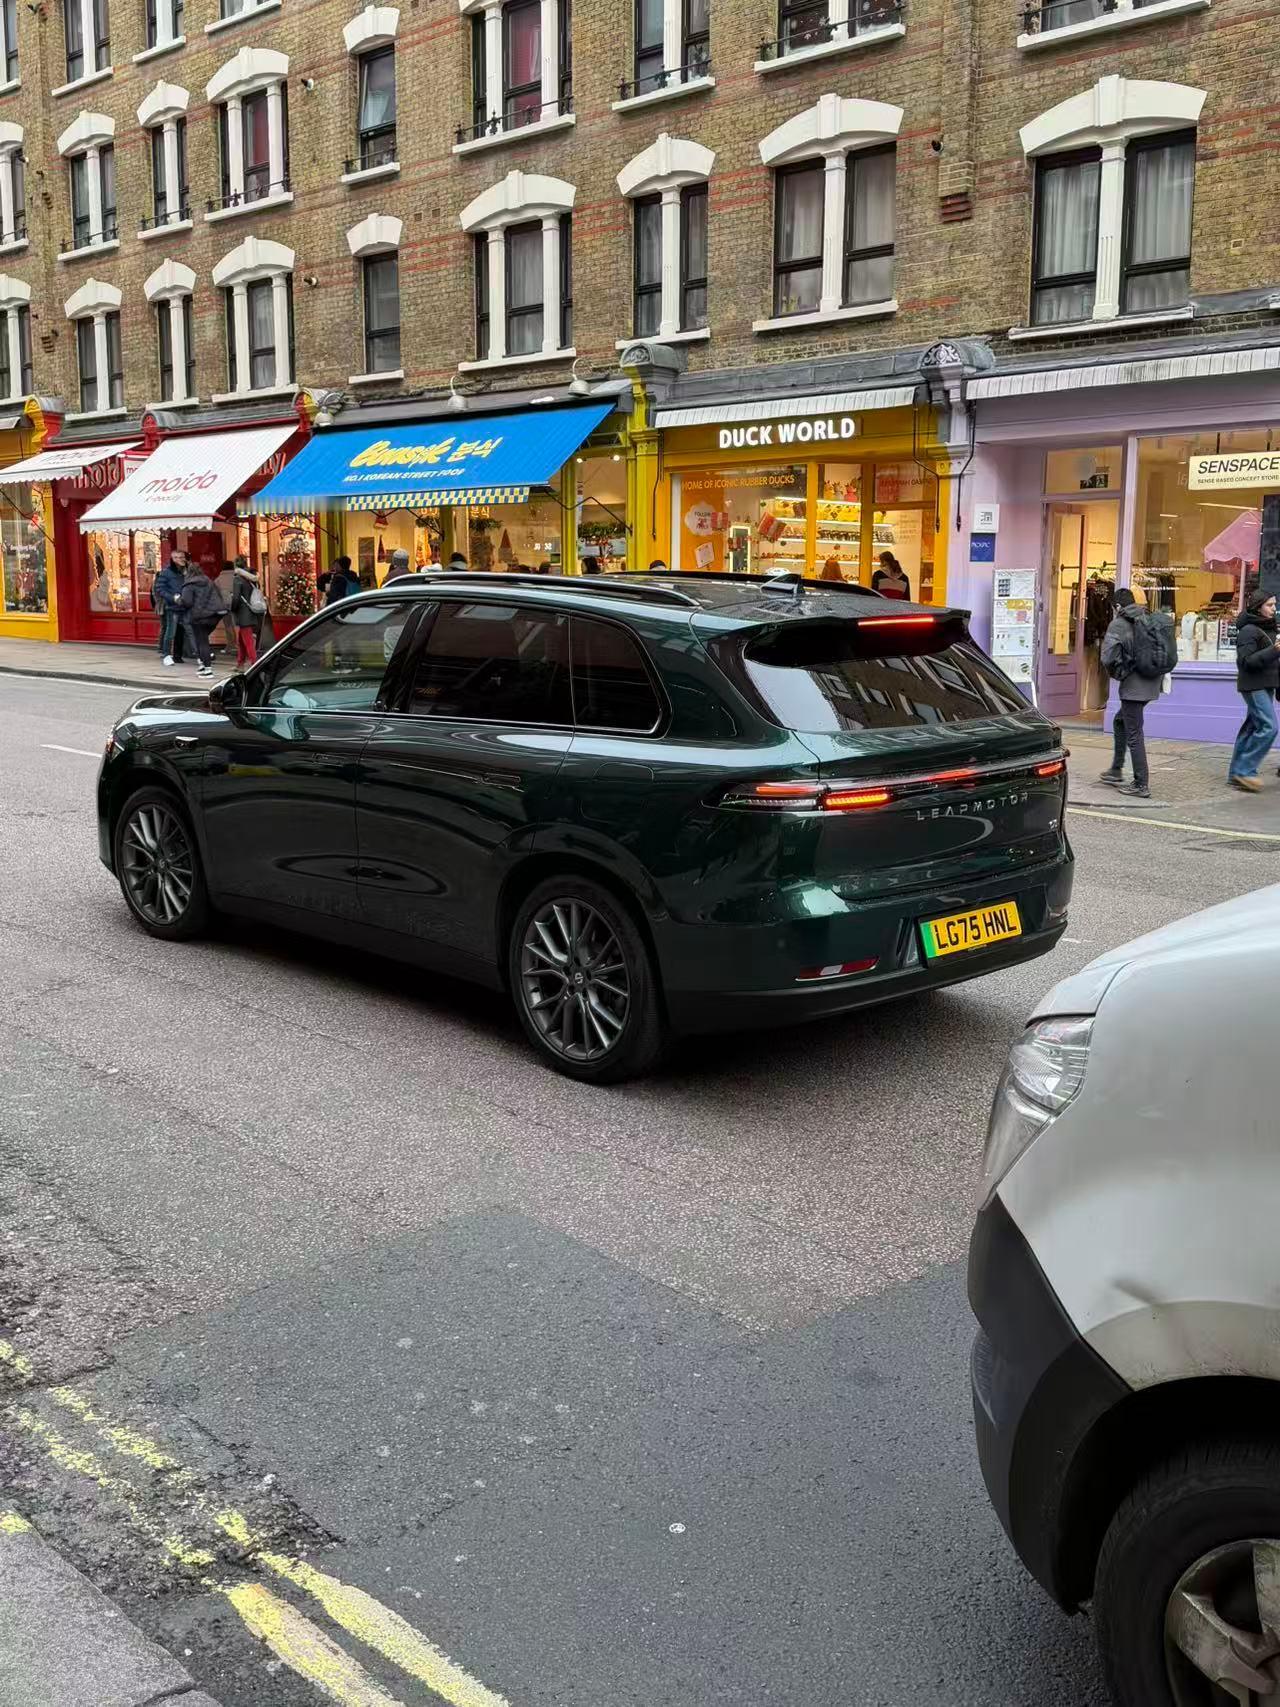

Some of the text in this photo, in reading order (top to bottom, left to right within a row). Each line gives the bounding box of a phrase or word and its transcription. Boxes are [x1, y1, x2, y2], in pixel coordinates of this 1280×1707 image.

[719, 418, 855, 448] DUCK WORLD
[364, 472, 401, 481] KOREAN
[401, 470, 438, 479] STREET
[1197, 456, 1280, 474] SENSPACE
[681, 480, 703, 490] HOME
[704, 479, 714, 489] OF
[740, 477, 768, 487] RUBBER
[768, 475, 795, 485] DUCKS
[916, 792, 1029, 821] LEAPMOTOR
[934, 908, 1017, 949] LG75 HNL
